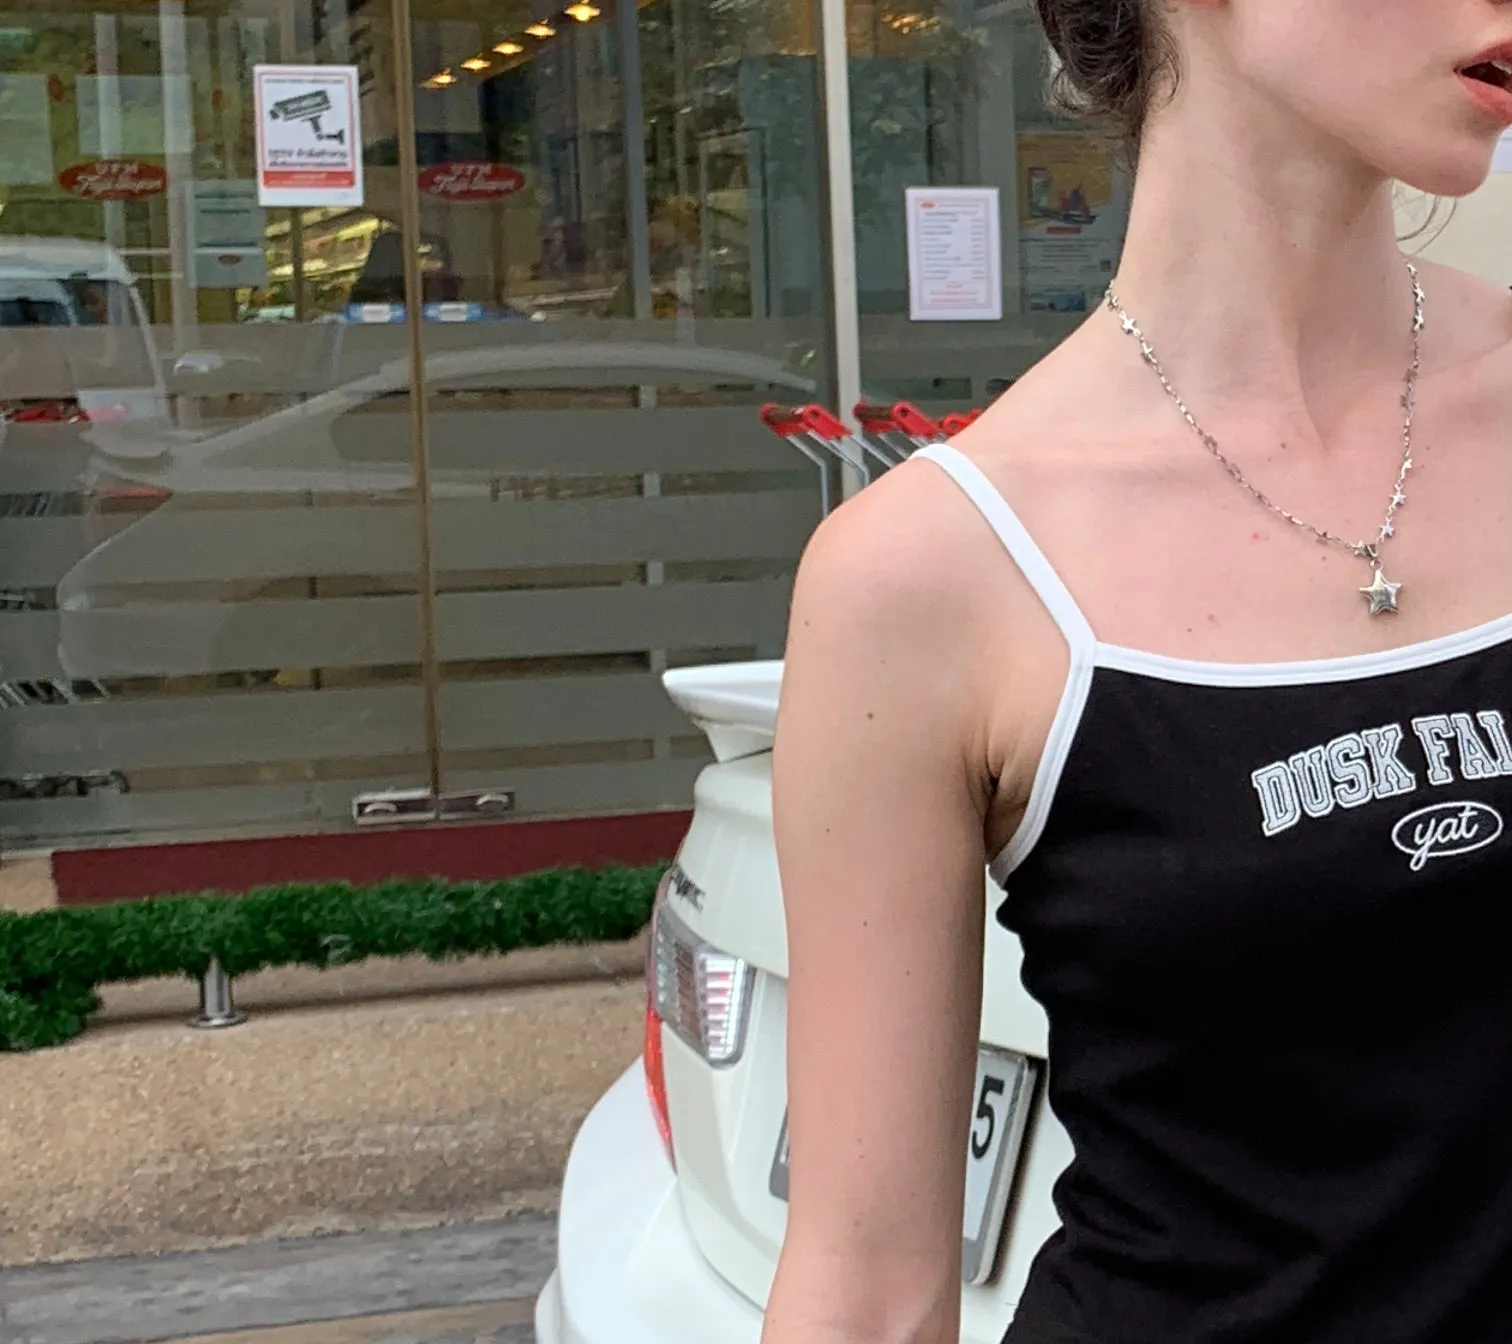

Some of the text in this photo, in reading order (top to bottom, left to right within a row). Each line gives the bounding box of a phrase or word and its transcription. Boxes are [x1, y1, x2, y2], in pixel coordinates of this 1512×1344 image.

[1251, 723, 1416, 837] DUSK
[1409, 803, 1479, 871] yat
[971, 1074, 1005, 1160] 5
